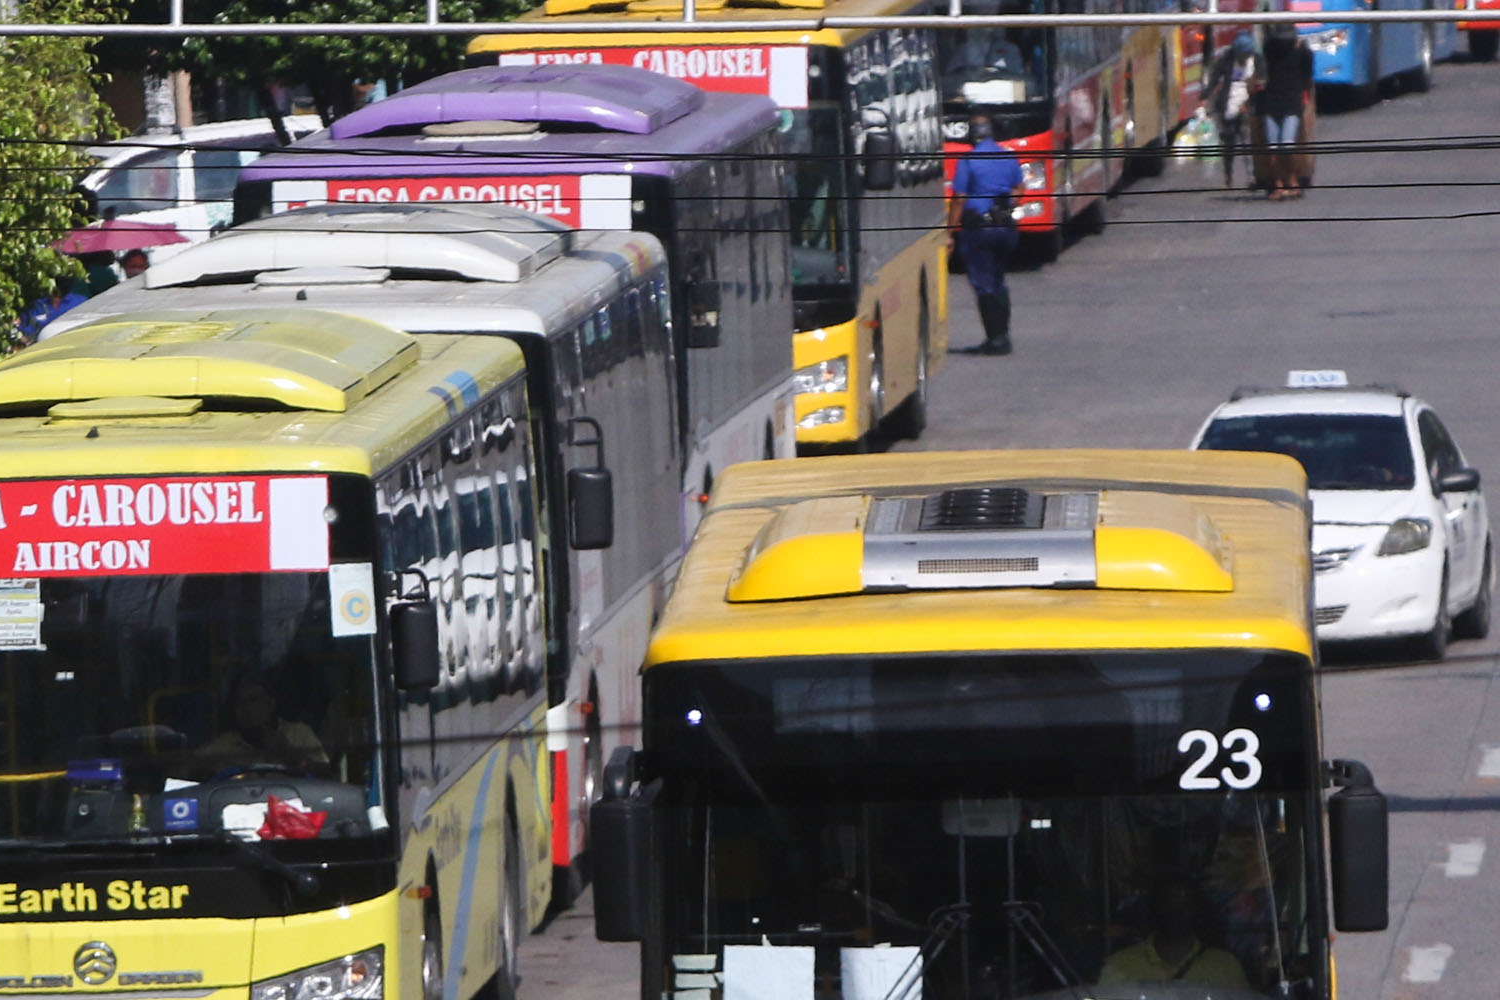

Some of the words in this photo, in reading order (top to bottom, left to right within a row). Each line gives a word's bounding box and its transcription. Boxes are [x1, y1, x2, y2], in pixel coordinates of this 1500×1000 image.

[633, 48, 766, 78] CAROUSEL
[52, 480, 264, 528] CAROUSEL
[12, 539, 151, 572] AIRCON
[346, 597, 365, 618] C
[1178, 728, 1263, 790] 23
[107, 879, 190, 911] Star
